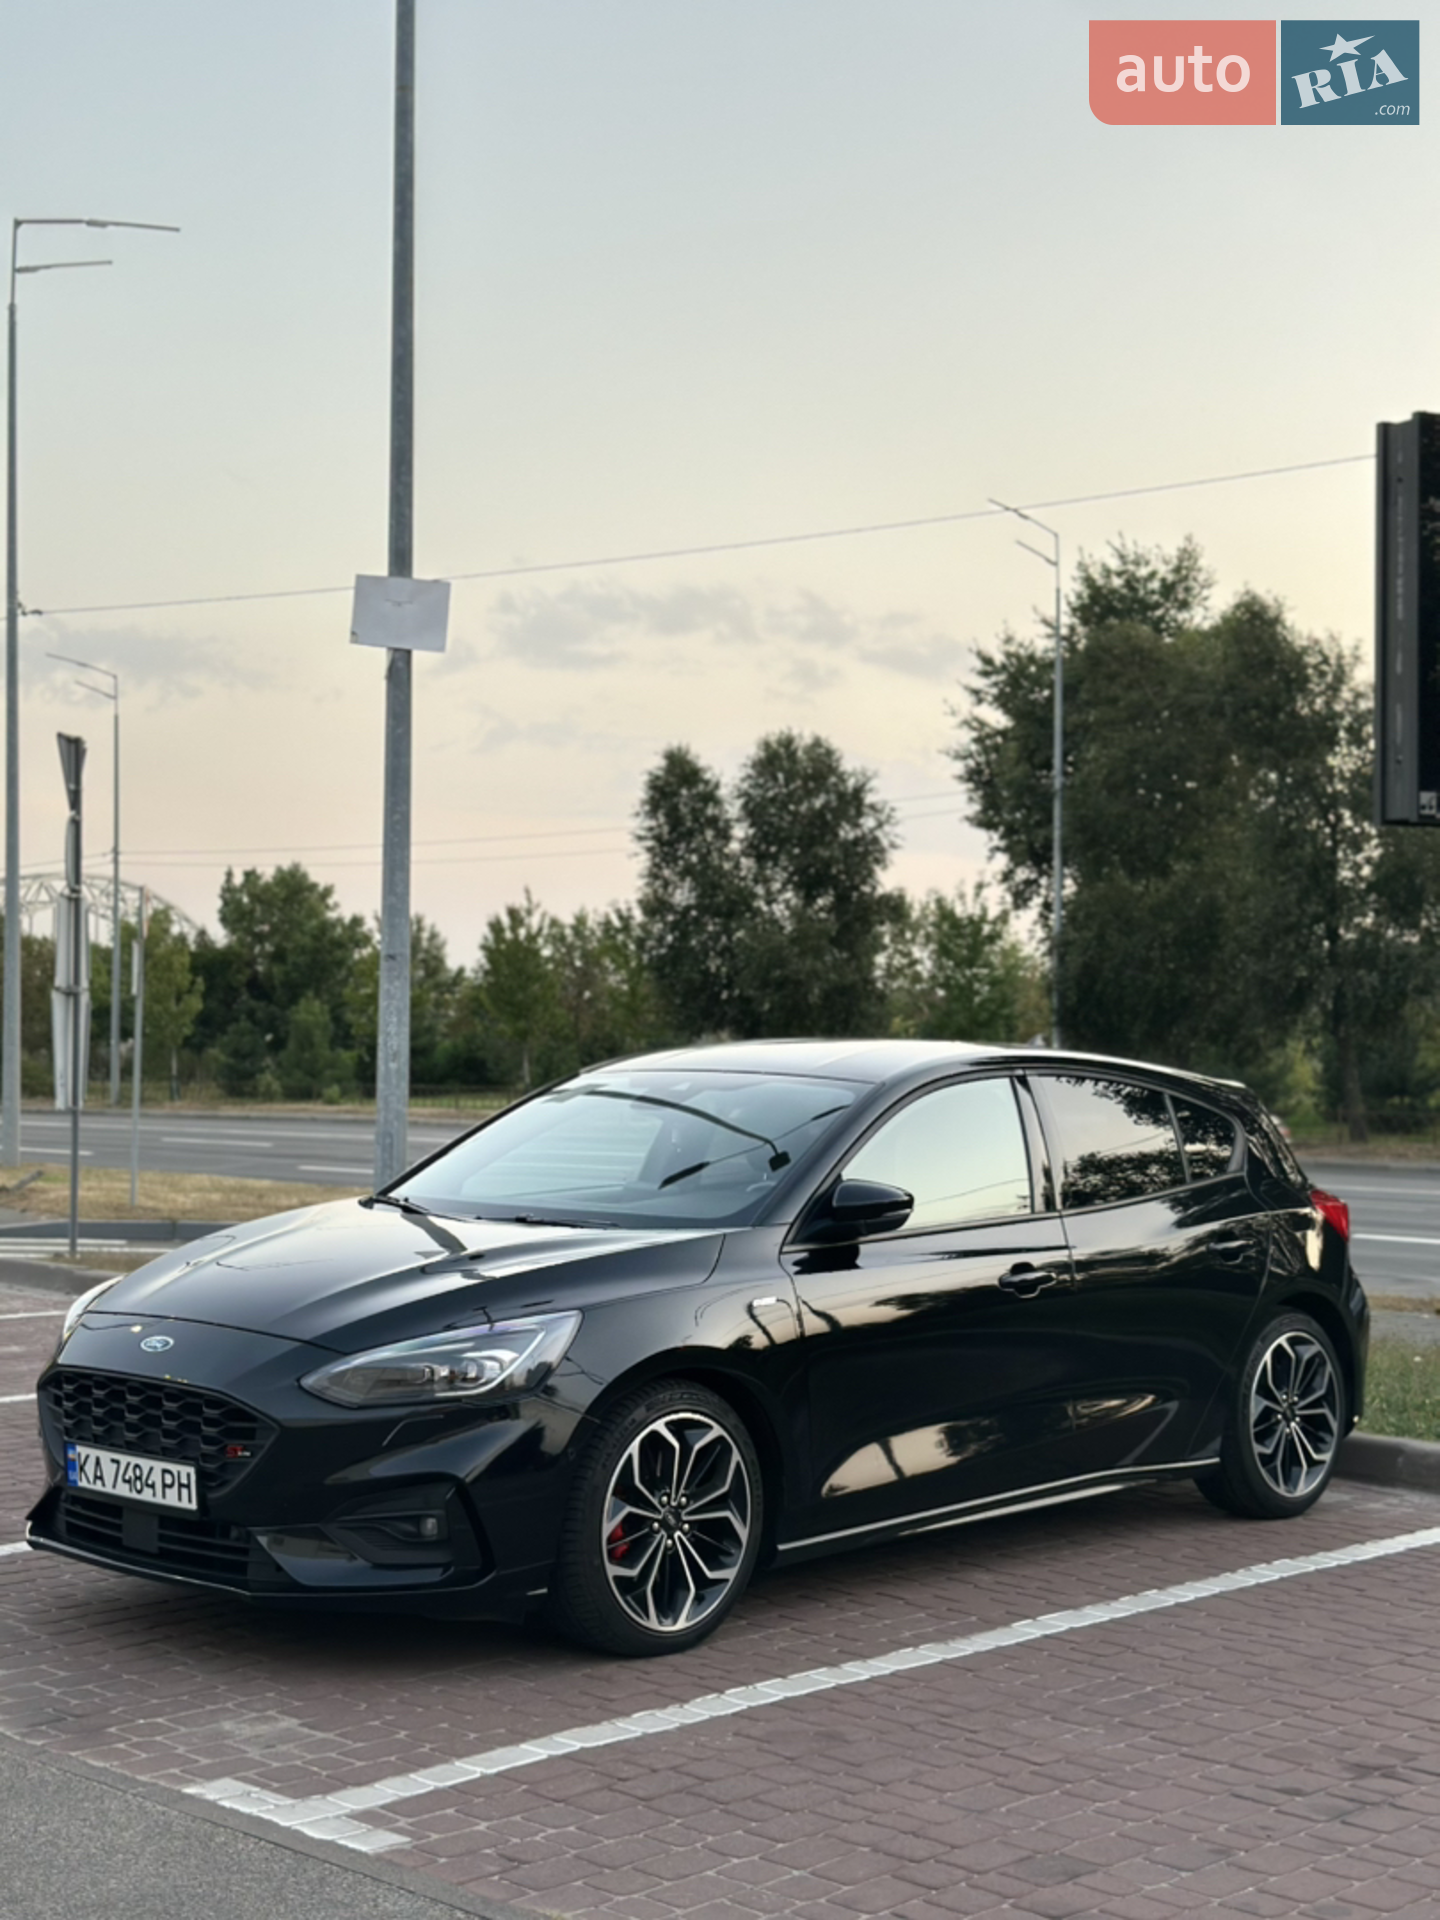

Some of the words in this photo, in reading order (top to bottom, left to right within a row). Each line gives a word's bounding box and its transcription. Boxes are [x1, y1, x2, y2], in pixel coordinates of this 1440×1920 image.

[78, 1452, 106, 1488] KA
[110, 1458, 157, 1498] 7484
[161, 1468, 193, 1504] PH
